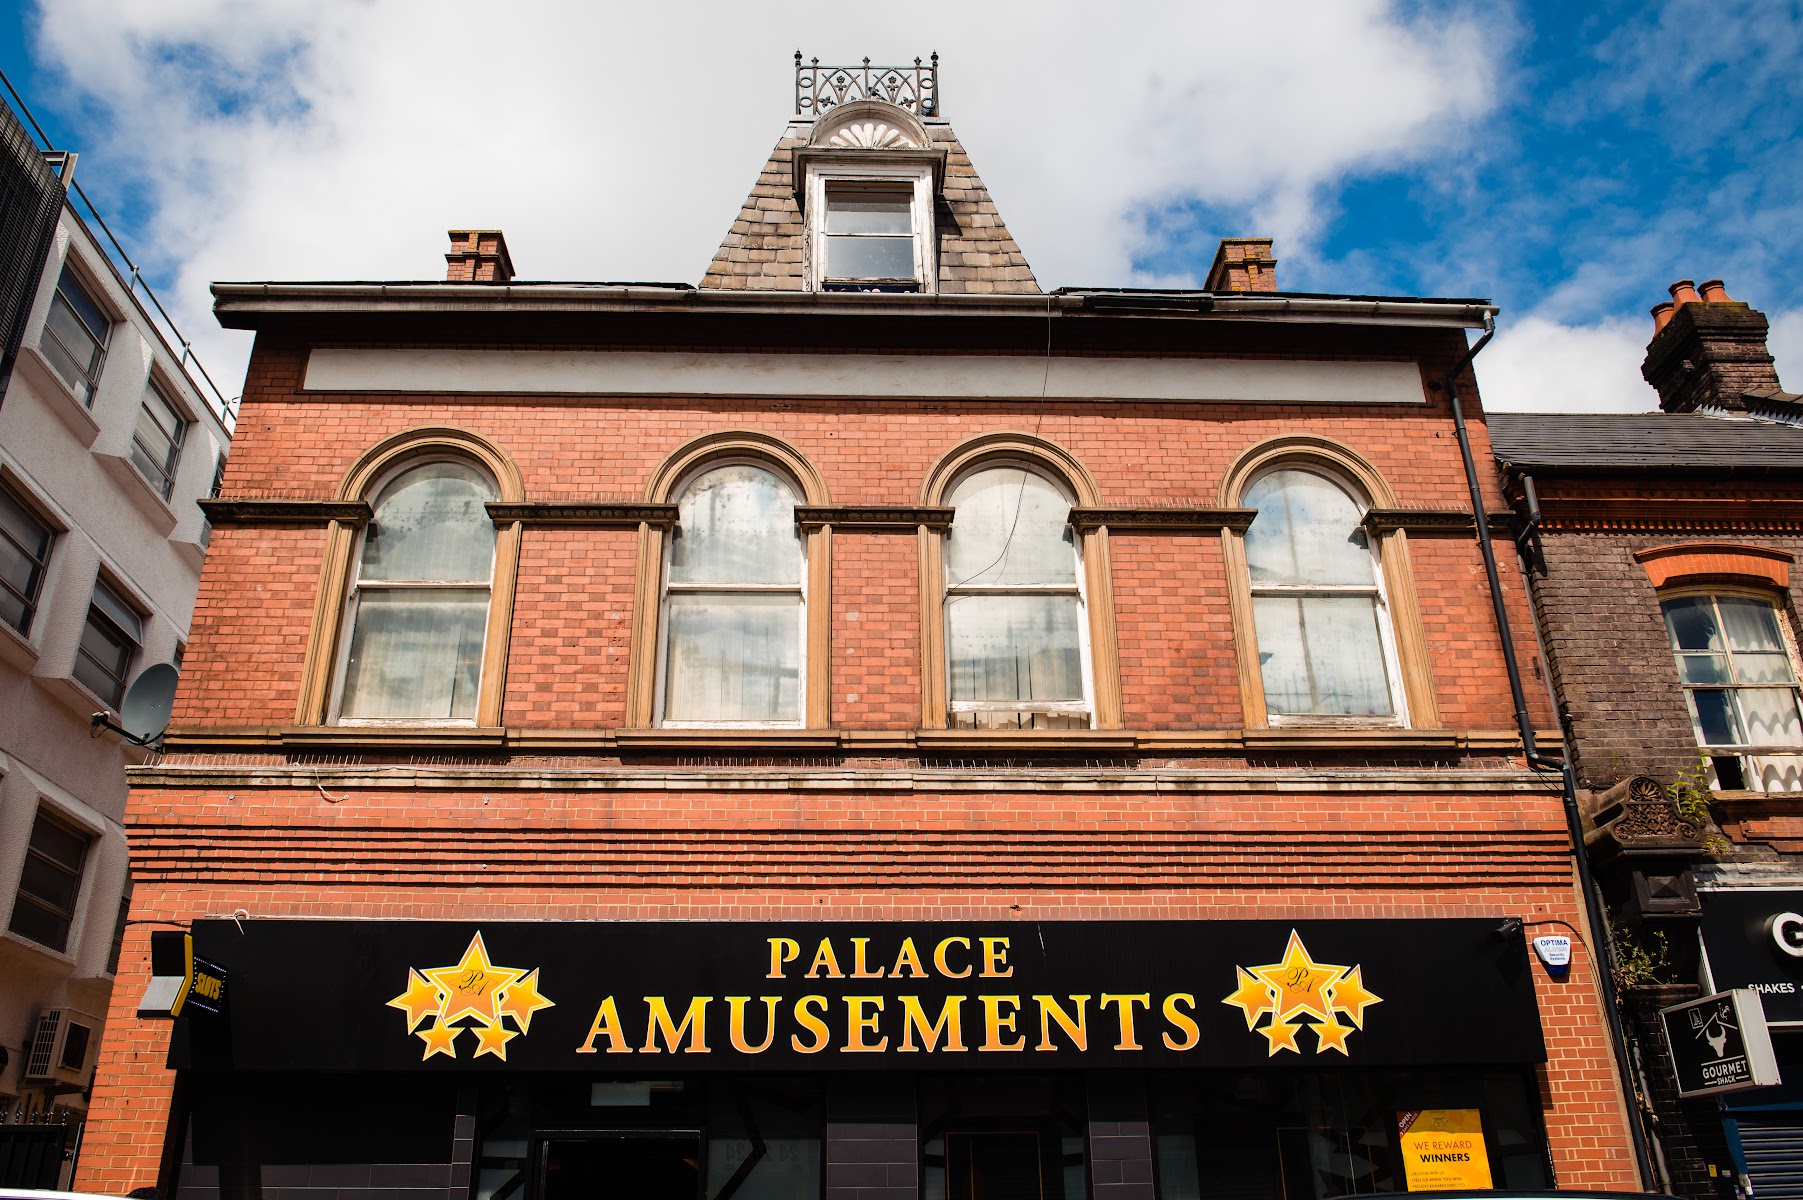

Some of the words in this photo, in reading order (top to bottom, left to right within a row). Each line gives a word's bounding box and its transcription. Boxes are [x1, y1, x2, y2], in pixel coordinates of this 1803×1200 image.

[766, 937, 1013, 978] PALACE
[195, 972, 222, 1000] SLOTS
[1748, 983, 1795, 994] SHAKES
[576, 993, 1200, 1053] AMUSEMENTS
[1702, 1060, 1747, 1079] GOURMET
[1717, 1075, 1736, 1085] SHACK
[1399, 1112, 1412, 1128] OPEN
[1414, 1142, 1429, 1150] WE
[1433, 1140, 1472, 1150] REWARD
[1420, 1153, 1470, 1163] WINNERS
